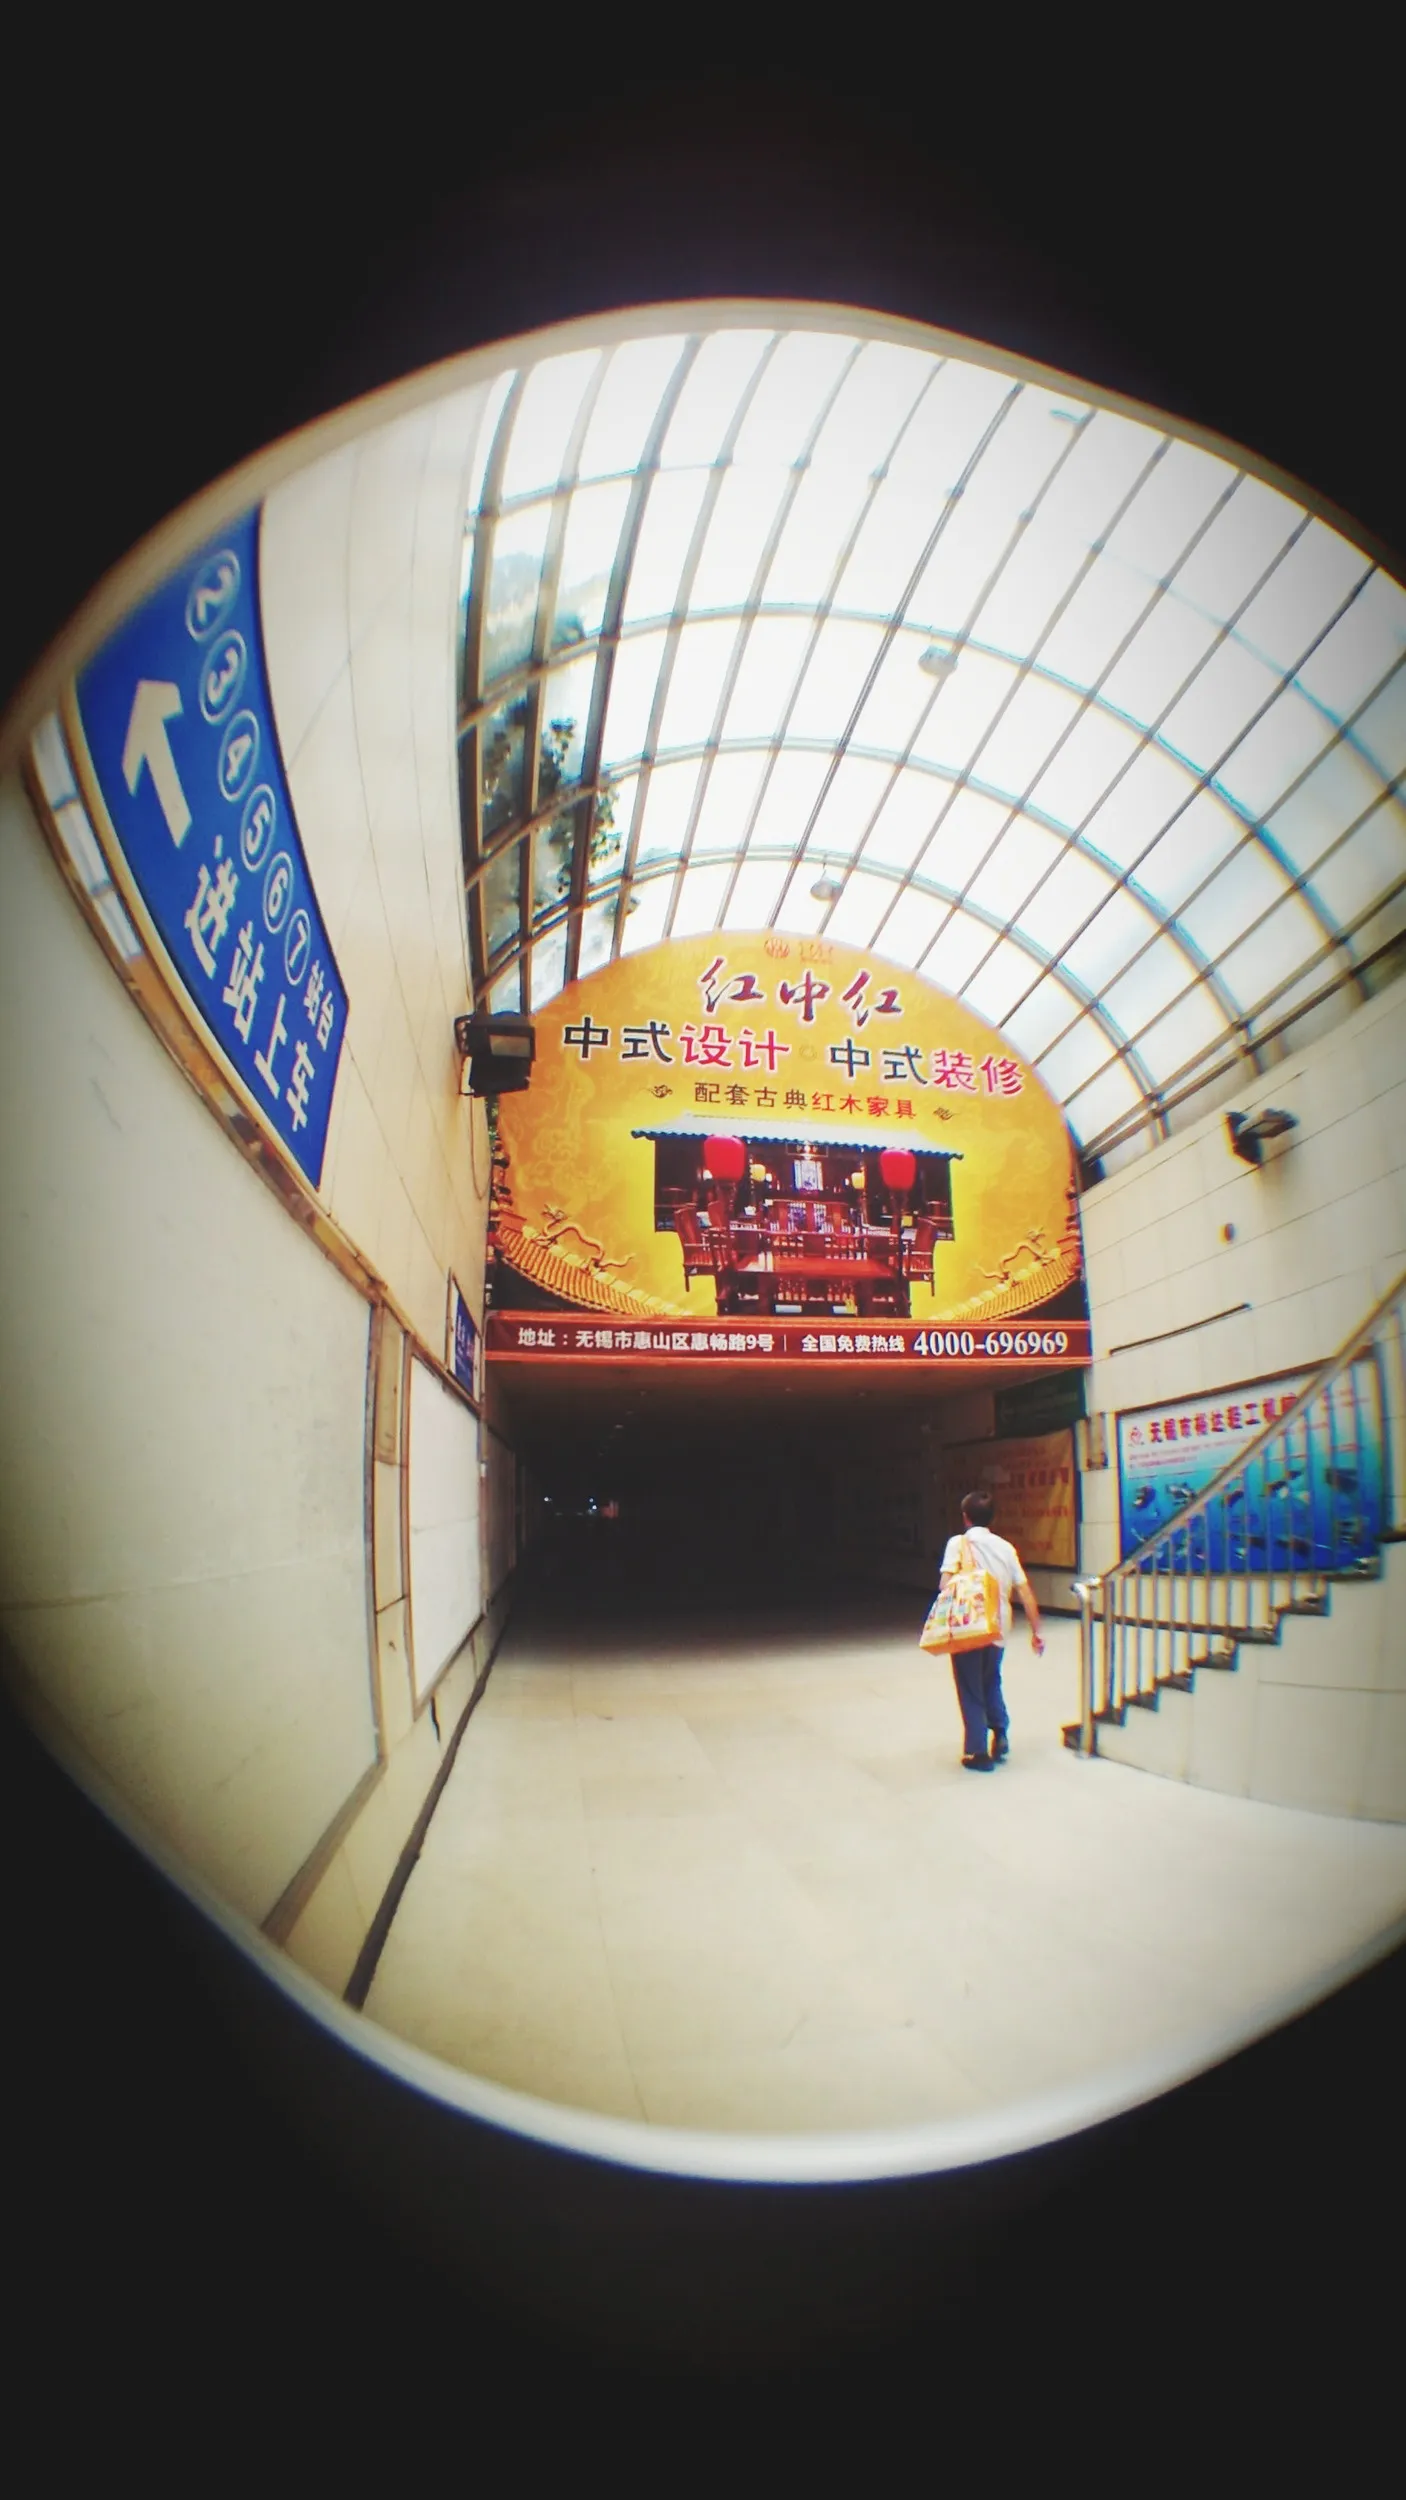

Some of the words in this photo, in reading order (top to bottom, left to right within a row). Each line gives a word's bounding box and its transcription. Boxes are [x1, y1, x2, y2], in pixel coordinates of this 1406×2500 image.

[185, 834, 316, 1132] 进站上车
[701, 956, 902, 1027] 红中红
[563, 1015, 790, 1071] 中式设计
[829, 1037, 1023, 1095] 中式装修
[694, 1081, 917, 1120] 配套古典红木家具
[801, 1333, 905, 1353] 全国免费热线
[913, 1330, 1069, 1356] 4000-696969
